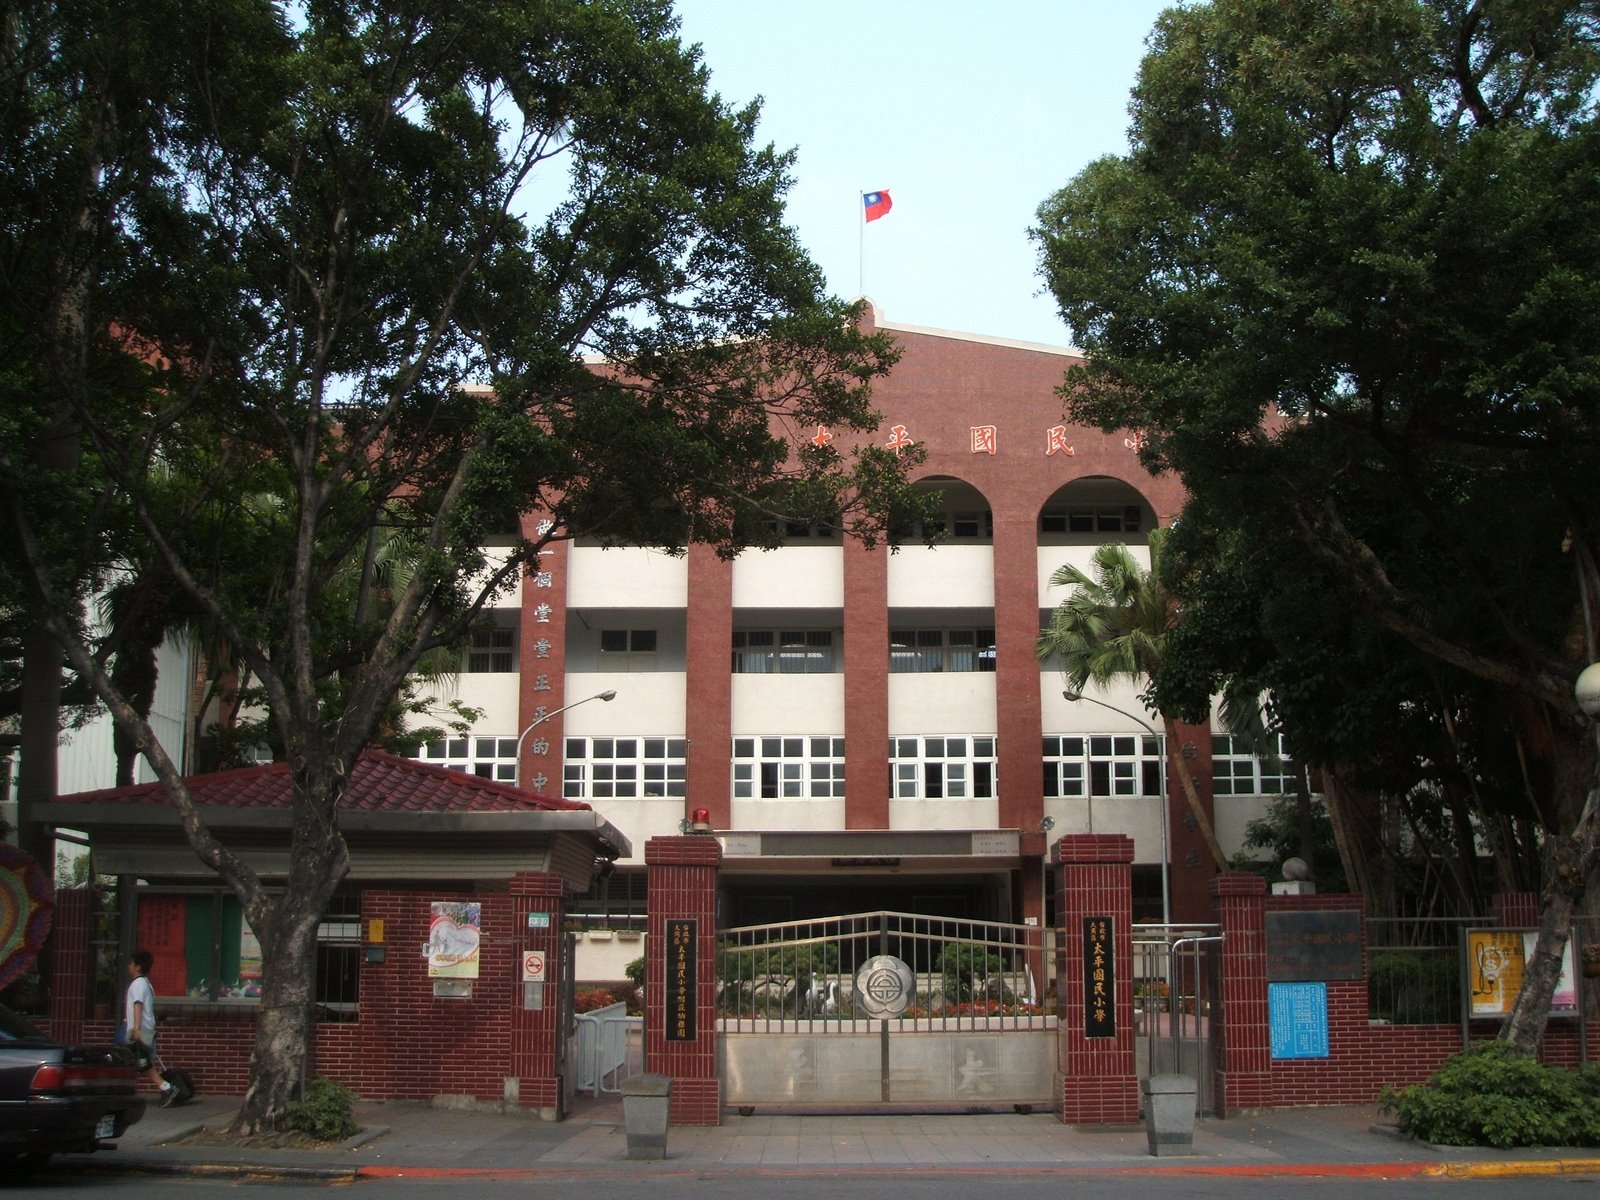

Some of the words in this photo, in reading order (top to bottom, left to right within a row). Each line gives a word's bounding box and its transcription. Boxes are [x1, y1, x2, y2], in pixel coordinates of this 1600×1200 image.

[1093, 943, 1106, 1021] 太平國民小學
